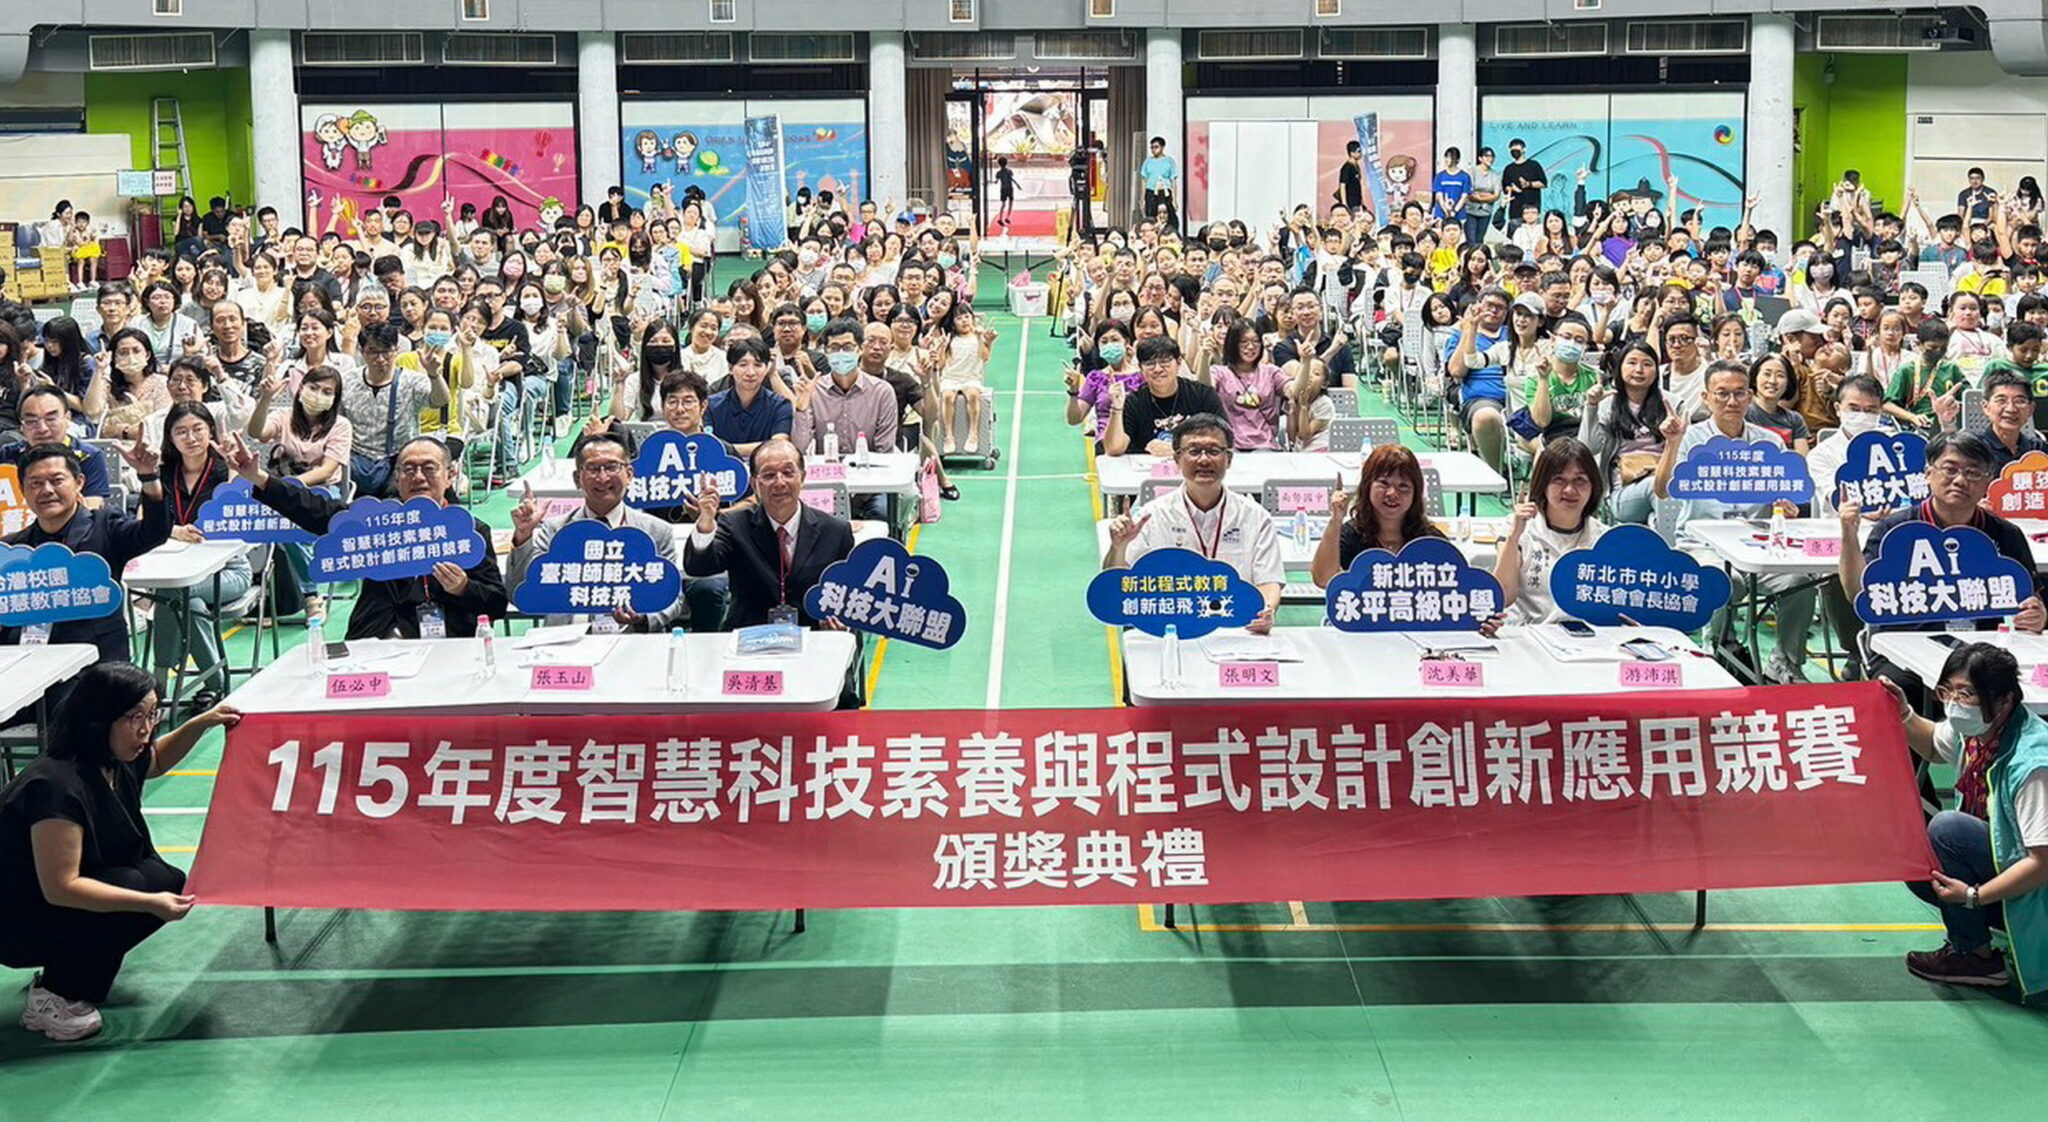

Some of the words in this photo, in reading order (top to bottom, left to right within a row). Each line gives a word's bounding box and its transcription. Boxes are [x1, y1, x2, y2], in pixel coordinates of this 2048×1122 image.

[1717, 451, 1765, 463] 115年度
[1697, 465, 1785, 478] 智慧科技素養與
[1678, 478, 1805, 492] 程式設計創新應用競賽
[2001, 491, 2046, 511] 創造
[364, 509, 422, 528] 115年度
[341, 525, 448, 552] 智慧科技素養與
[320, 538, 473, 573] 程式設計創新應用競賽
[584, 539, 625, 560] 國立
[0, 566, 69, 591] 灣校園
[540, 562, 665, 584] 臺灣師範大學
[1372, 562, 1459, 588] 新北市立
[1577, 563, 1700, 592] 新北市中小學
[1121, 575, 1229, 593] 新北程式教育
[569, 586, 632, 607] 科技系
[1335, 589, 1496, 622] 永平高級中學
[1575, 584, 1699, 614] 家長會會長協會
[1867, 575, 2019, 615] 科技大聯盟
[818, 581, 952, 644] 科技大聯盟
[1122, 598, 1194, 616] 創新起飛
[536, 670, 586, 685] 張玉山
[727, 674, 778, 691] 吳清基
[1224, 667, 1275, 683] 張明文
[1427, 665, 1478, 682] 沈美華
[1624, 667, 1678, 684] 游沛淇
[332, 676, 382, 693] 伍必中
[267, 704, 1867, 825] 115年度智慧科技素養與程式設計創新應用競賽
[932, 828, 1209, 890] 頒獎典禮
